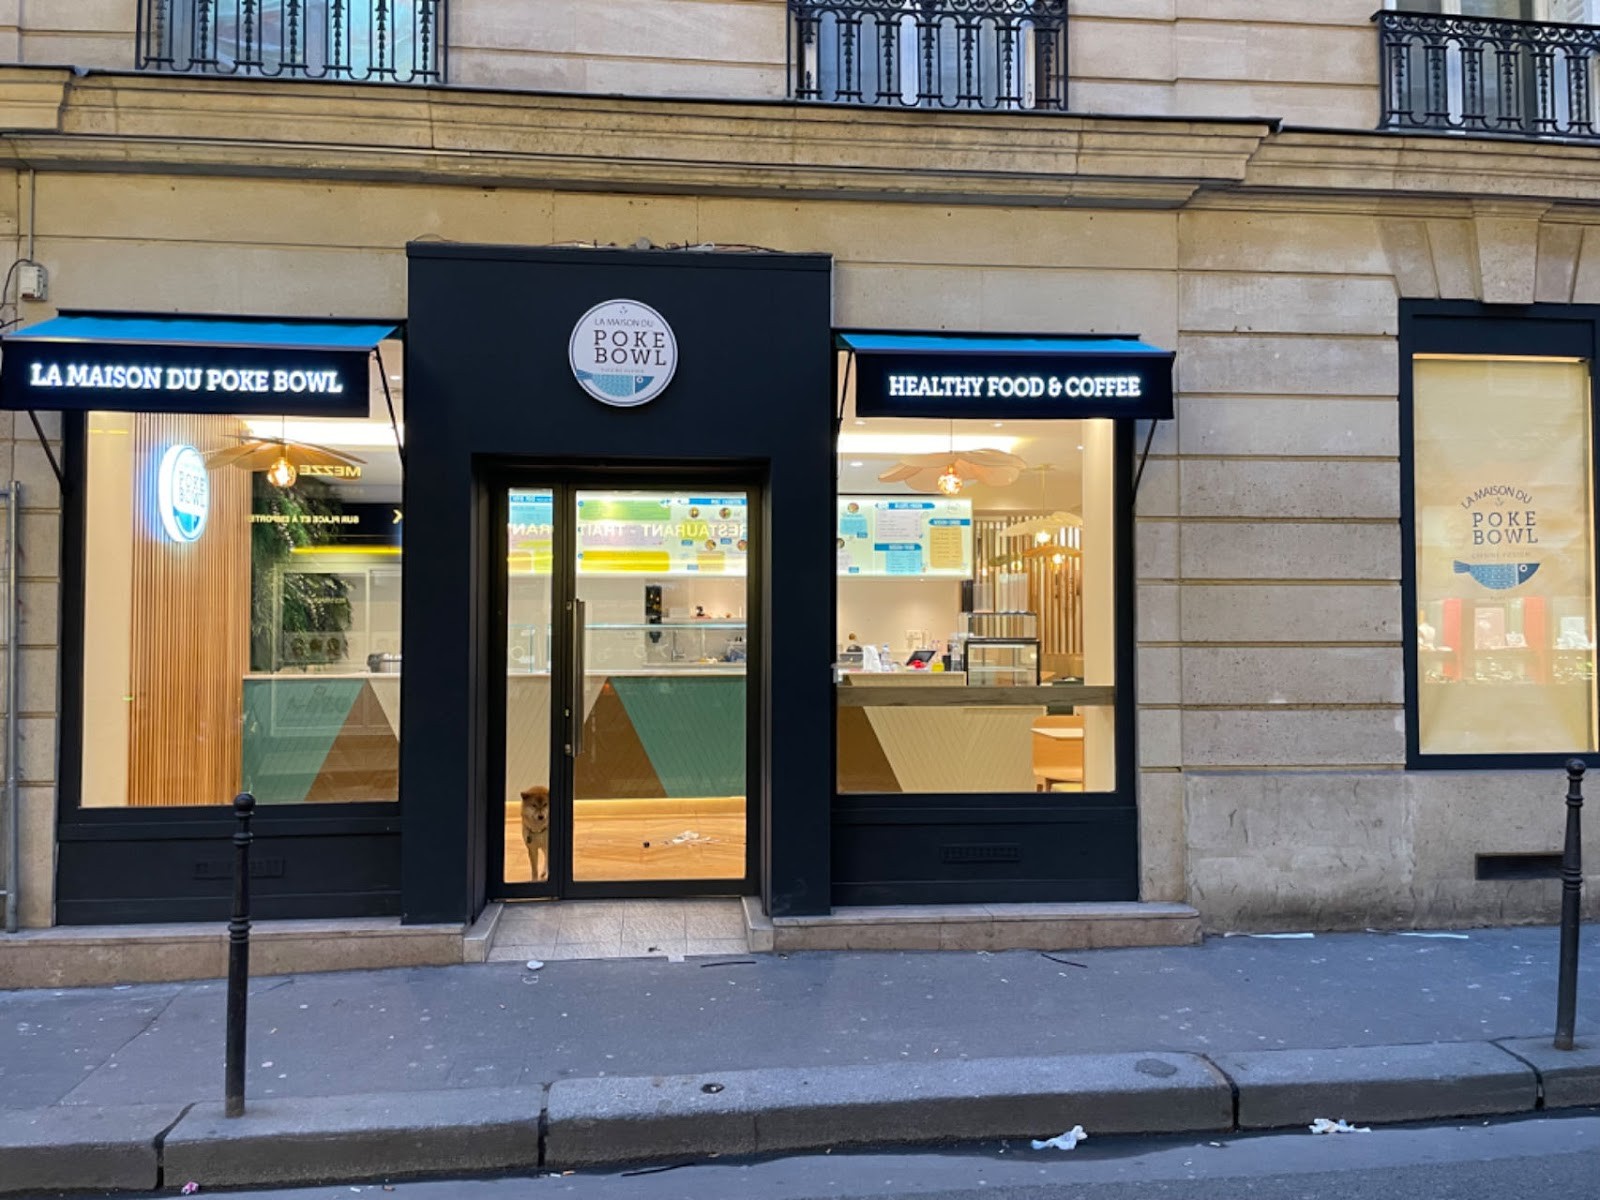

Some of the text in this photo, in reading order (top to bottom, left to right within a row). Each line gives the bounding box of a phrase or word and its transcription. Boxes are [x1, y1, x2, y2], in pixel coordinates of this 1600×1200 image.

[594, 318, 653, 328] LA MAISON DU
[594, 329, 665, 348] POKE
[594, 347, 666, 366] BOWL
[30, 363, 343, 393] LA MAISON DU POKE BOWL
[889, 375, 1141, 397] HEALTHY FOOD & COFFEE
[1461, 485, 1533, 509] LA MAISON DU
[1472, 511, 1536, 528] POKE
[1473, 528, 1539, 545] BOWL
